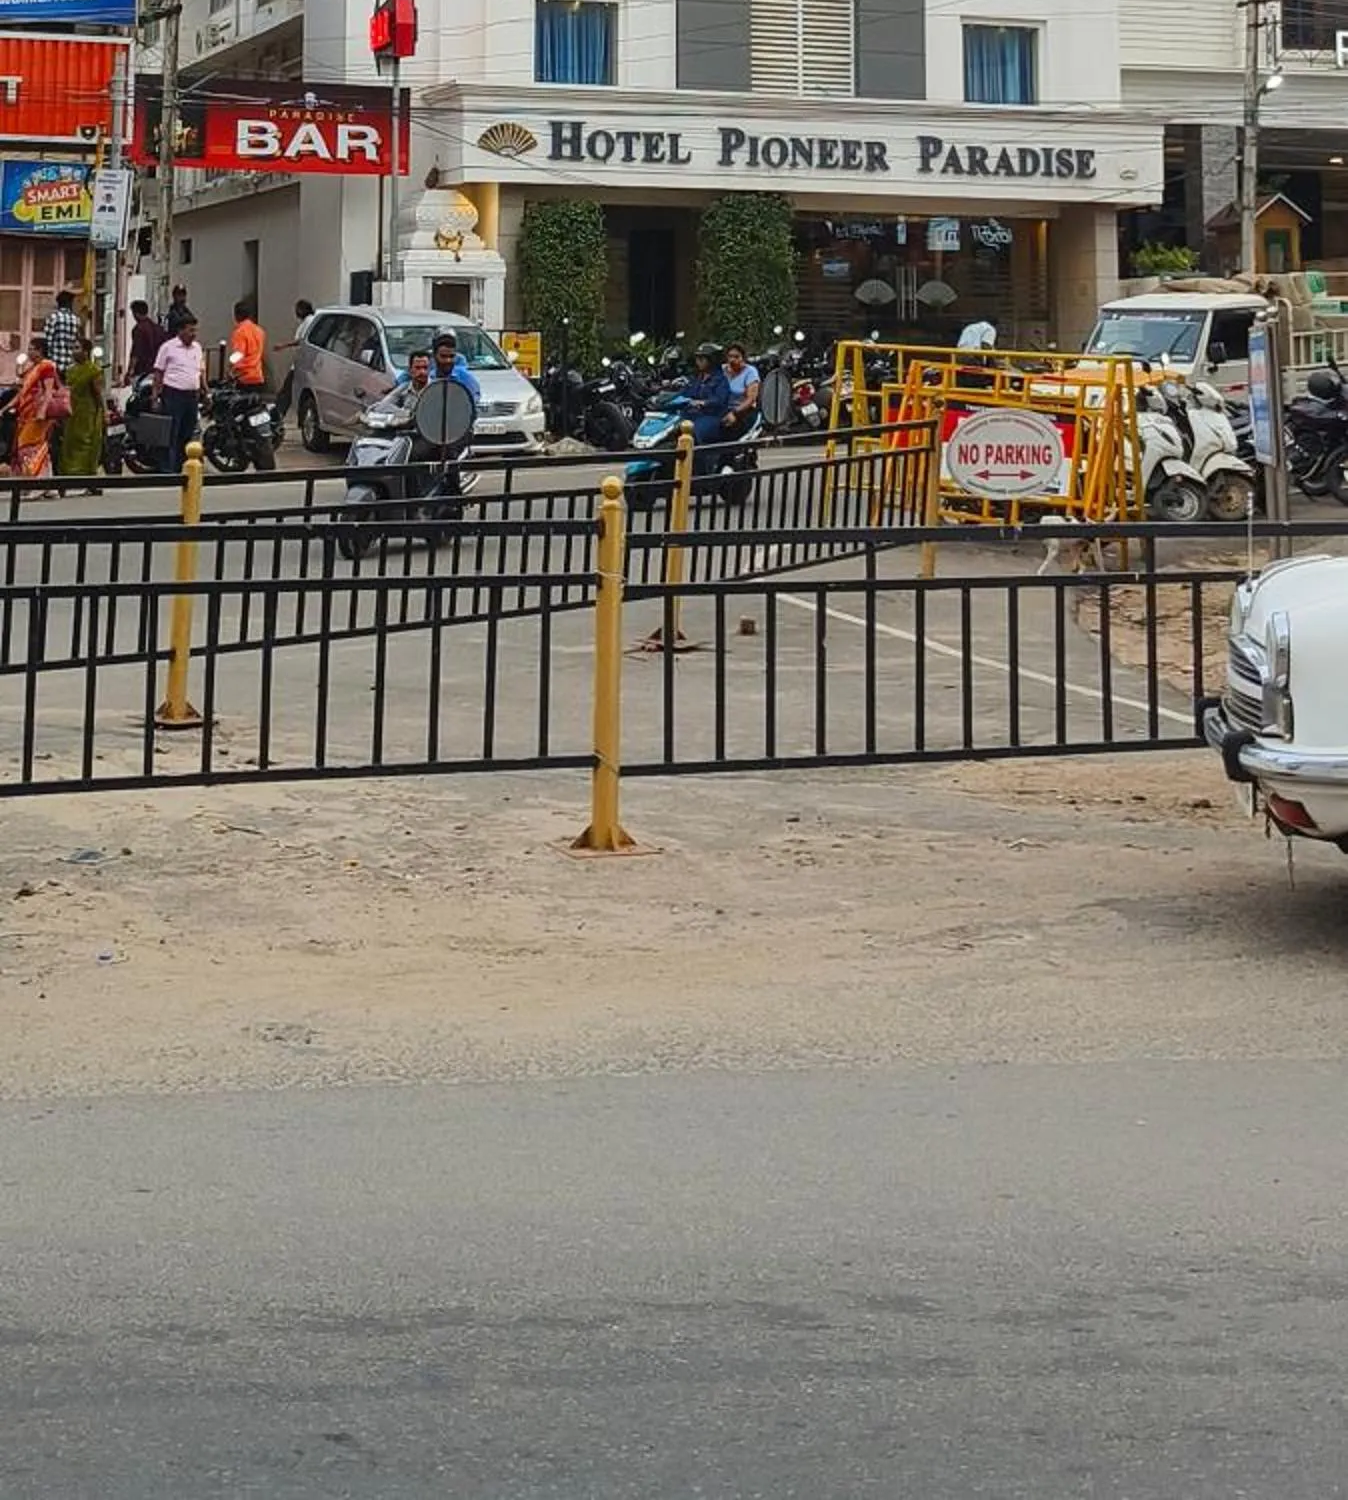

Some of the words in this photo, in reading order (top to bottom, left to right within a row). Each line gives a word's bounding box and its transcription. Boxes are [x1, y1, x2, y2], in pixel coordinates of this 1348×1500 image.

[236, 119, 382, 164] BAR
[547, 120, 692, 164] HOTEL
[717, 127, 891, 170] PIONEER
[916, 135, 1097, 179] PARADISE
[26, 183, 80, 204] SMART
[41, 204, 81, 220] EMI
[958, 443, 979, 465] NO
[985, 444, 1052, 465] PARKING
